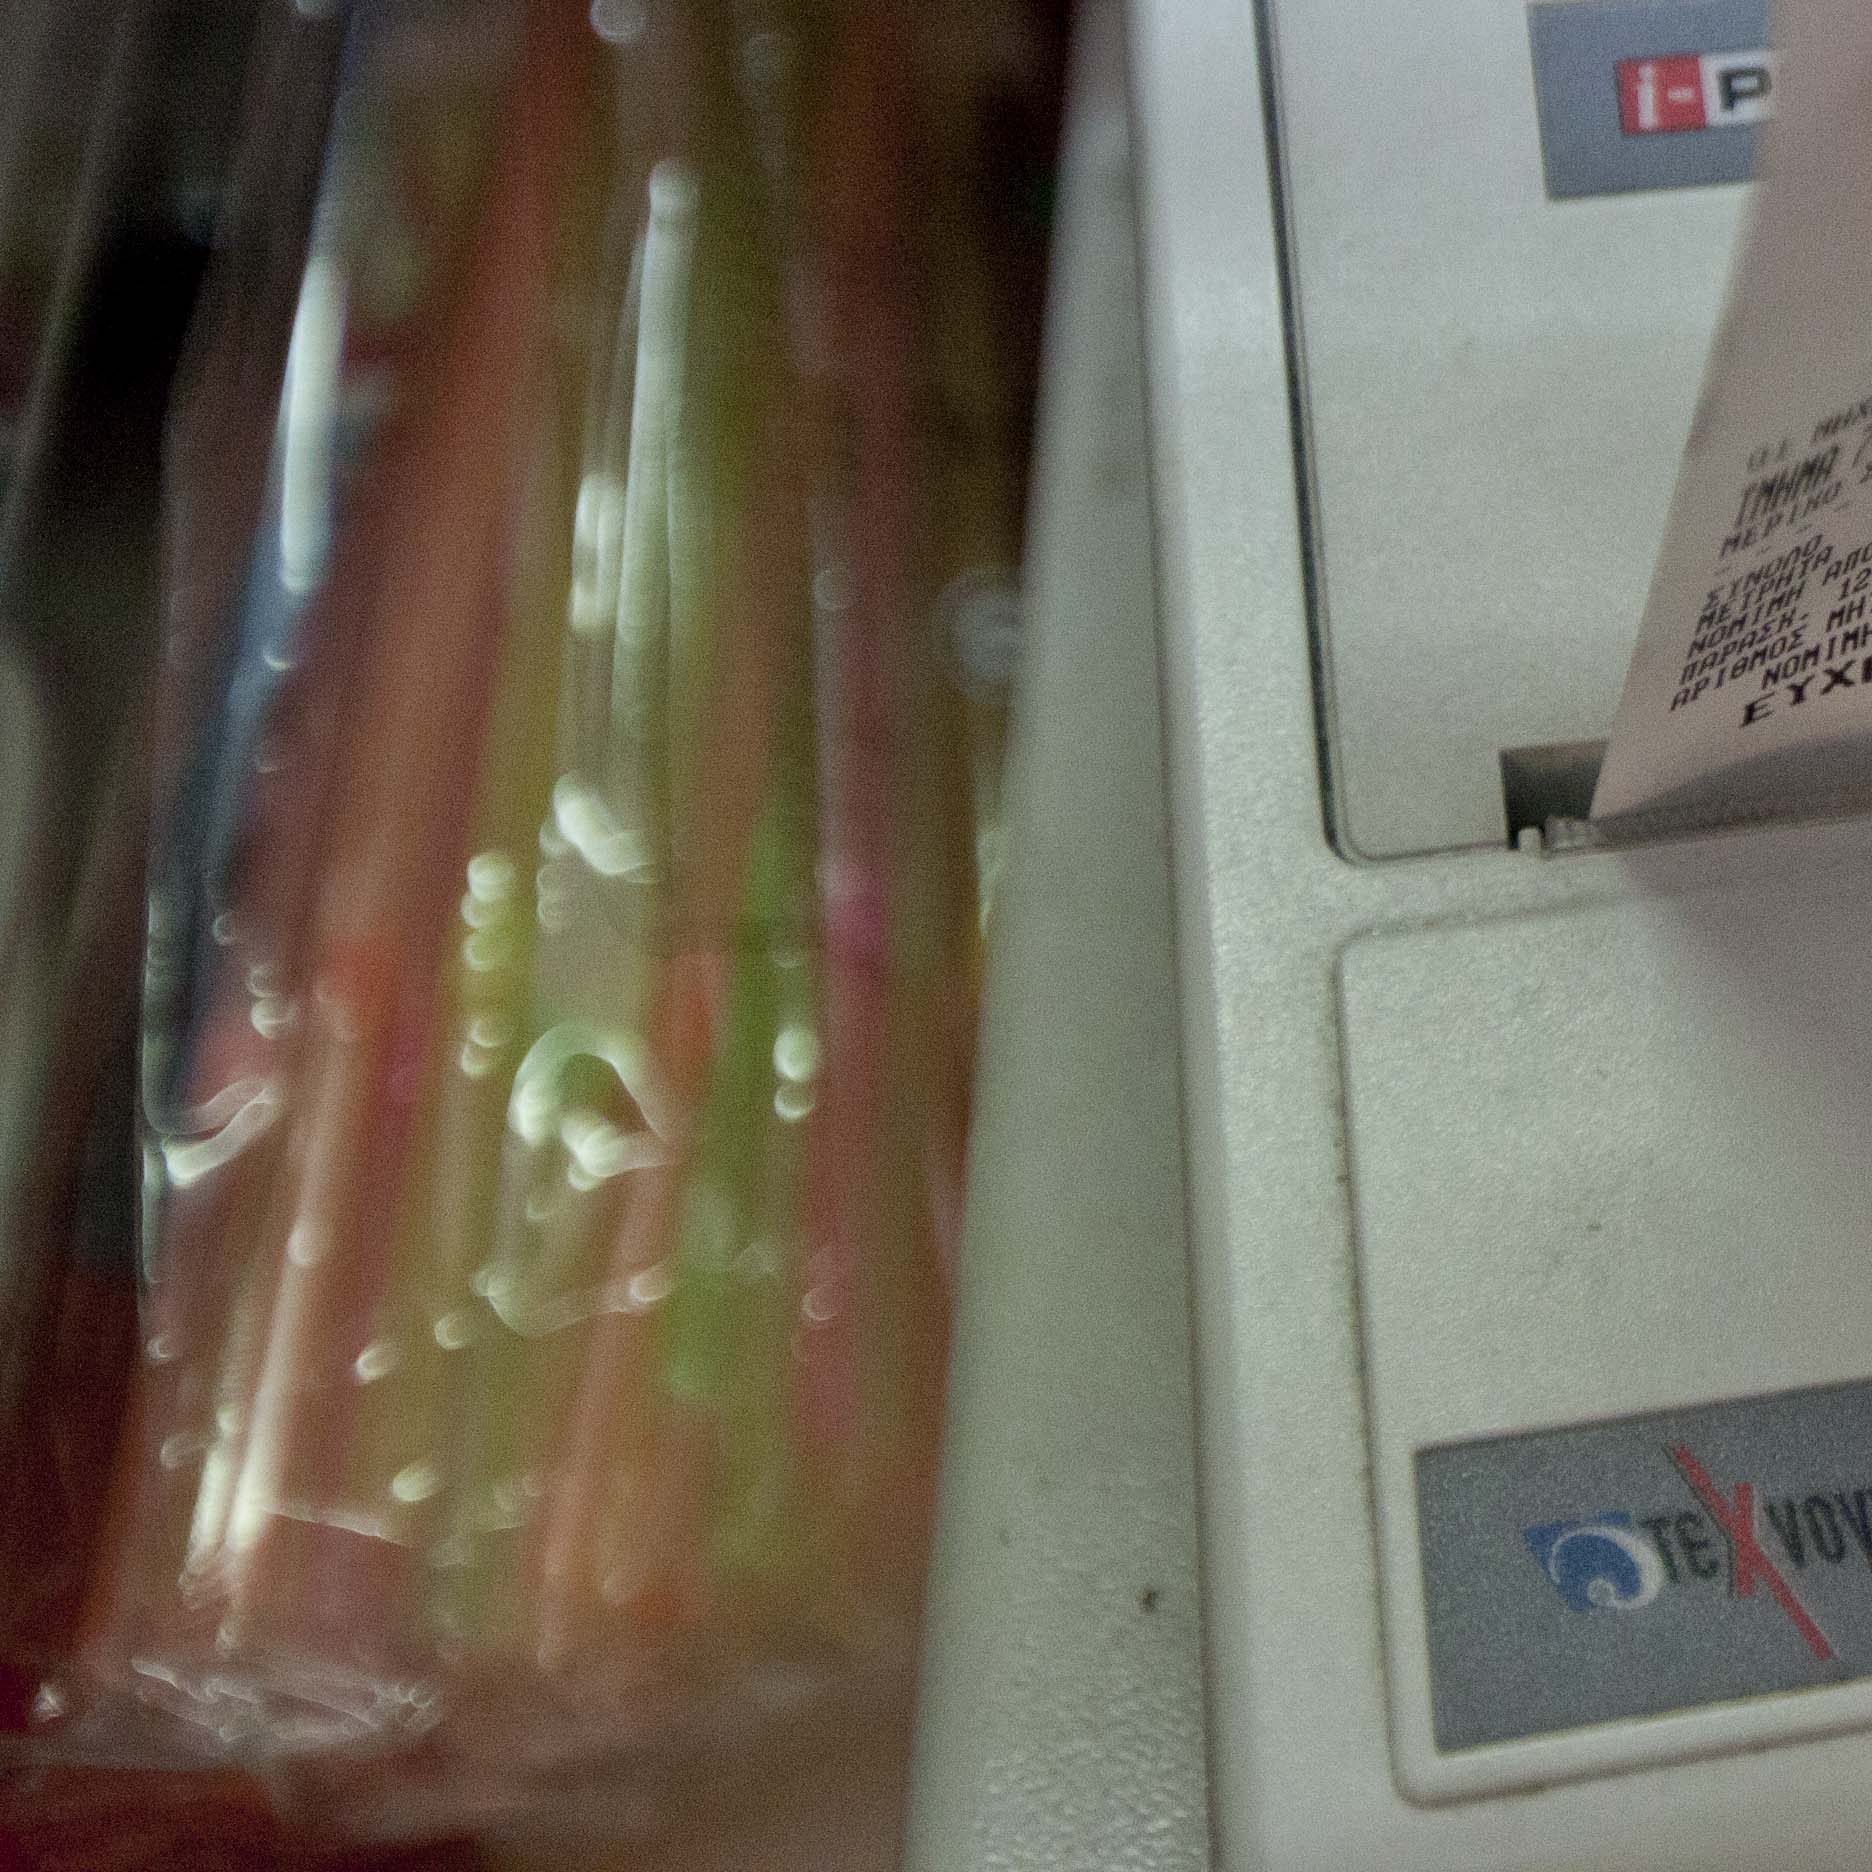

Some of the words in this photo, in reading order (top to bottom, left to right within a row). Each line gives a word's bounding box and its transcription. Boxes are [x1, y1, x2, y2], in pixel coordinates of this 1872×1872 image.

[1700, 533, 1824, 612] ΣΥΝΟΛΟ
[1839, 567, 1872, 602] 12
[1669, 624, 1807, 713] ΑΡΙΘΜΟΣ
